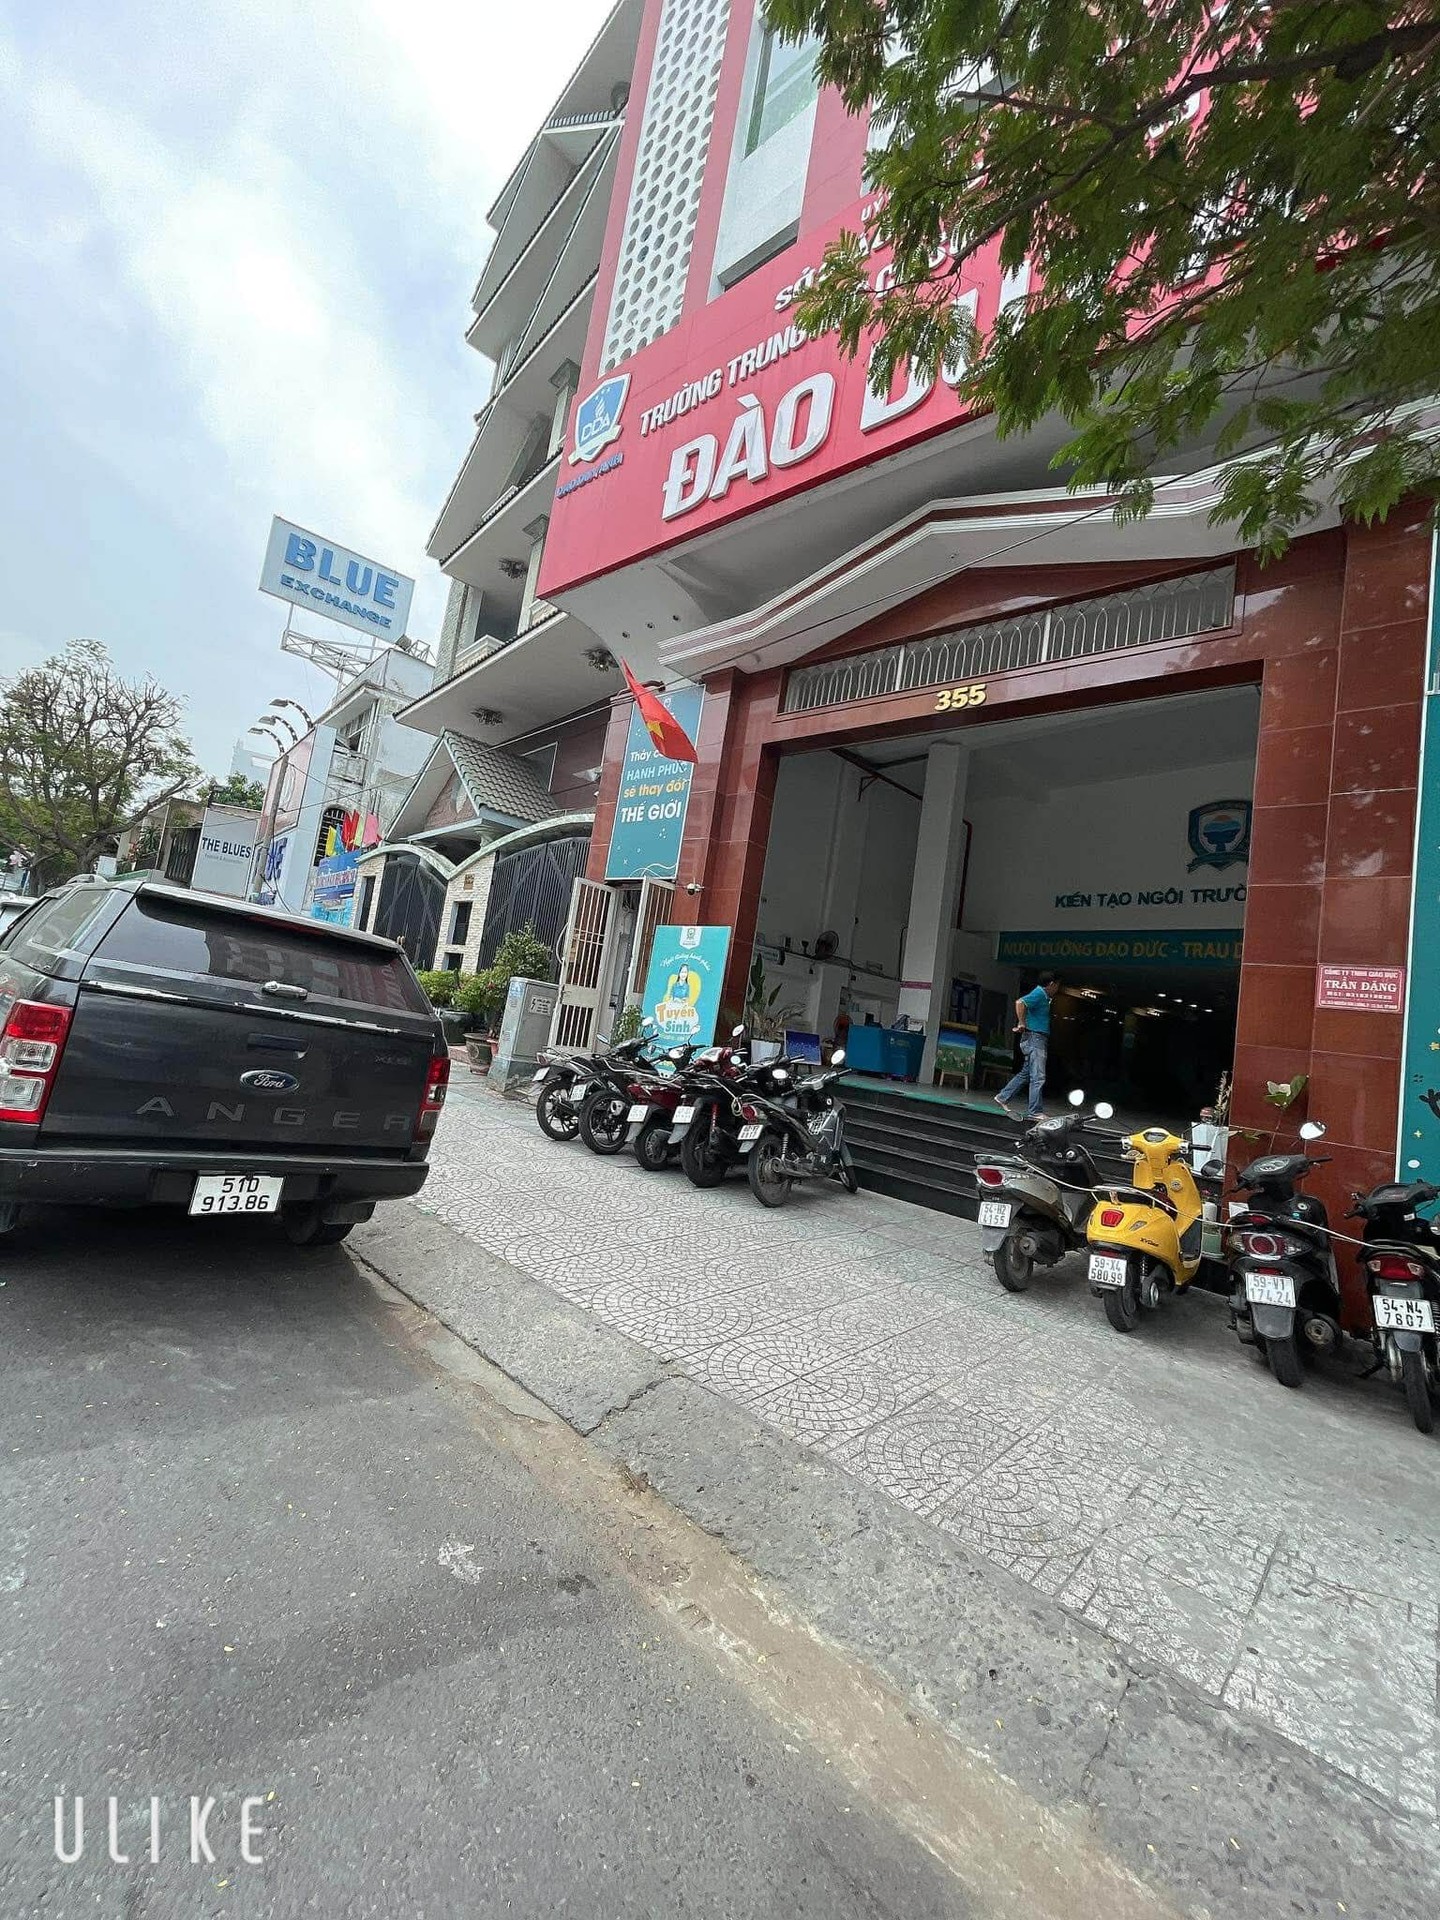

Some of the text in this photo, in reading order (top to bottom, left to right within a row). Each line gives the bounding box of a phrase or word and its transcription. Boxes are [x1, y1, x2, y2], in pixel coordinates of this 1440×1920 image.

[661, 372, 837, 522] ĐÀO
[284, 533, 400, 610] BLUE
[280, 574, 392, 629] EXCHANGE
[934, 684, 987, 711] 355
[639, 782, 662, 798] thay
[620, 799, 682, 823] THẾ GIỚI
[202, 837, 221, 852] THE
[222, 841, 251, 859] BLUES
[1097, 891, 1132, 909] TẠO
[1137, 888, 1184, 906] NGÔI
[1324, 976, 1358, 990] TRẦN
[664, 1021, 690, 1033] Sinh
[253, 1073, 286, 1089] Ford
[222, 1177, 260, 1195] 51D
[200, 1194, 271, 1213] 913.86
[1094, 1258, 1121, 1272] 59-X4
[1090, 1268, 1123, 1285] 580.99
[1253, 1275, 1286, 1291] 59-V1
[1250, 1287, 1292, 1308] 174.24
[1382, 1298, 1423, 1314] 54-N4
